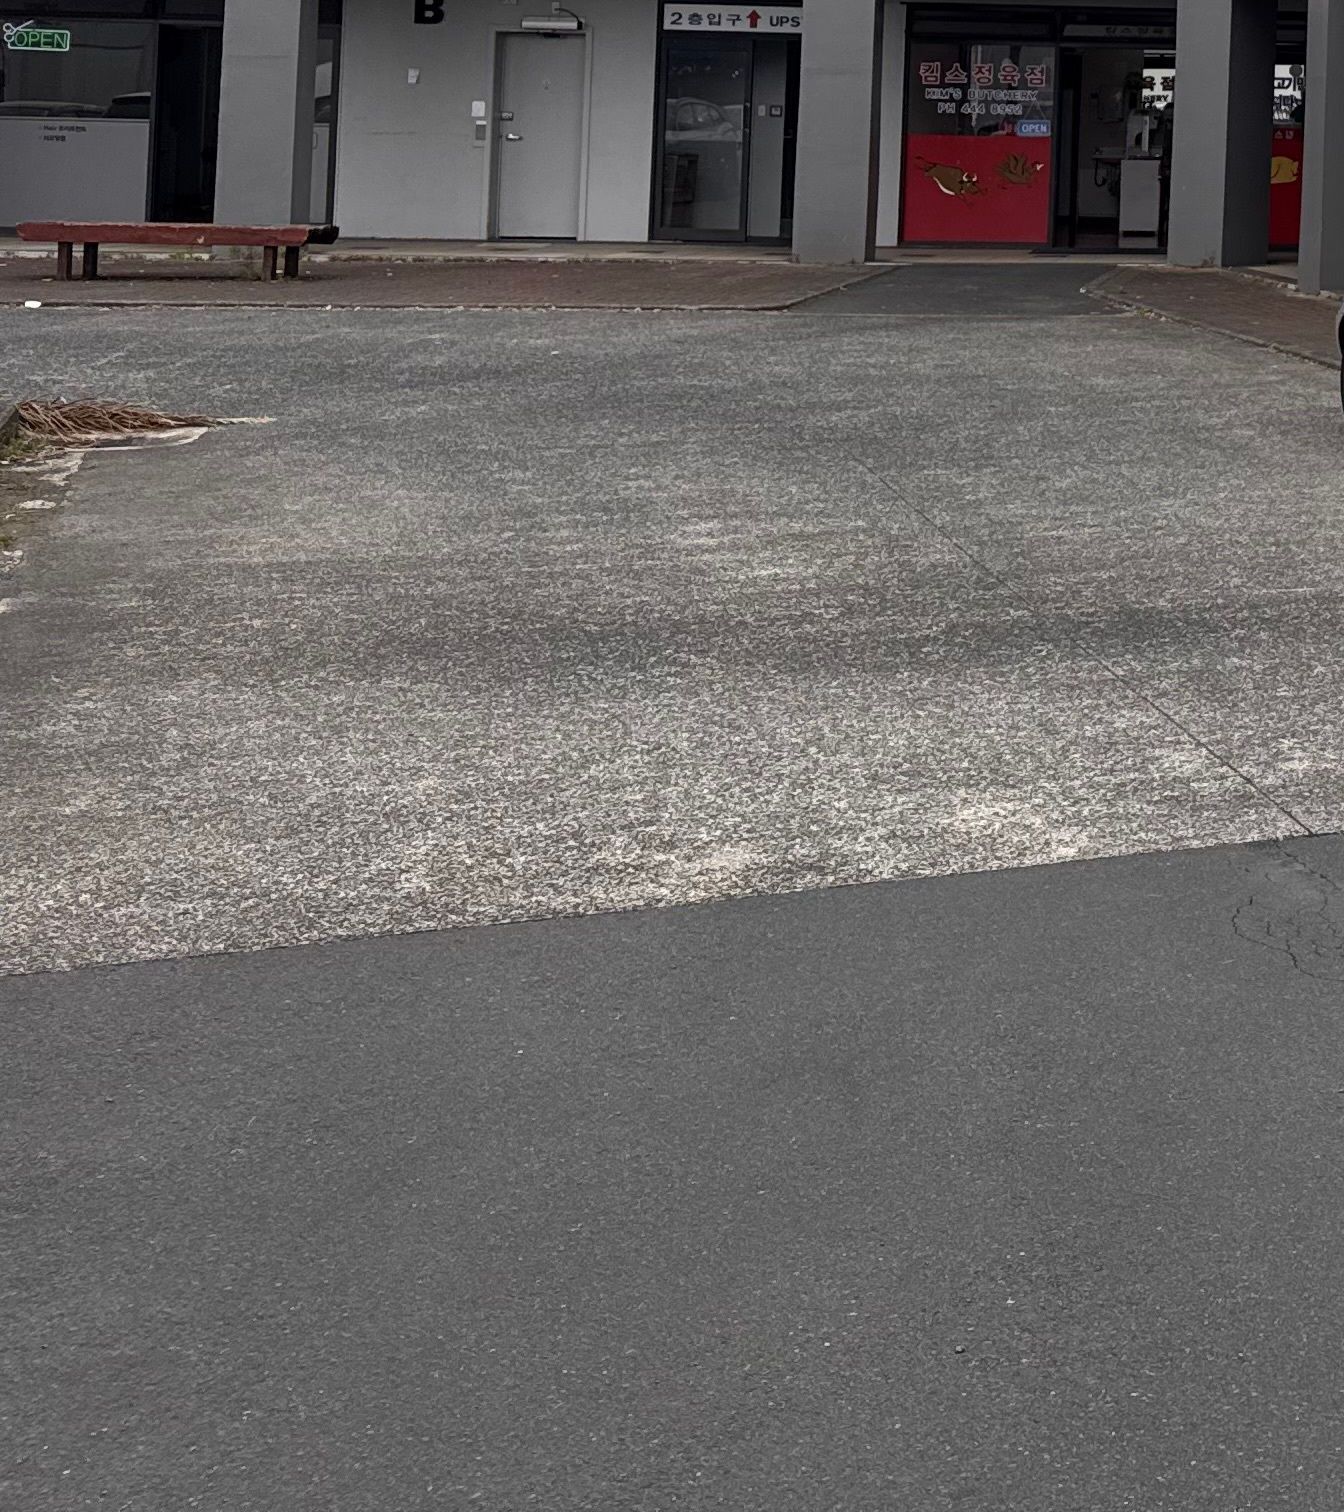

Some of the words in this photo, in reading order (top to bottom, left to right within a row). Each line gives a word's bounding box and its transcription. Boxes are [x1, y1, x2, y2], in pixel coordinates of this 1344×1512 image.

[769, 15, 801, 28] UPS
[13, 30, 68, 50] OPEN
[919, 61, 1047, 88] 킴스정육점
[925, 87, 962, 100] KIM'S
[968, 88, 1039, 101] BUTCHERY
[937, 102, 956, 114] PH
[961, 102, 986, 115] 444
[990, 103, 1023, 116] 8952
[1021, 123, 1048, 133] OPEN
